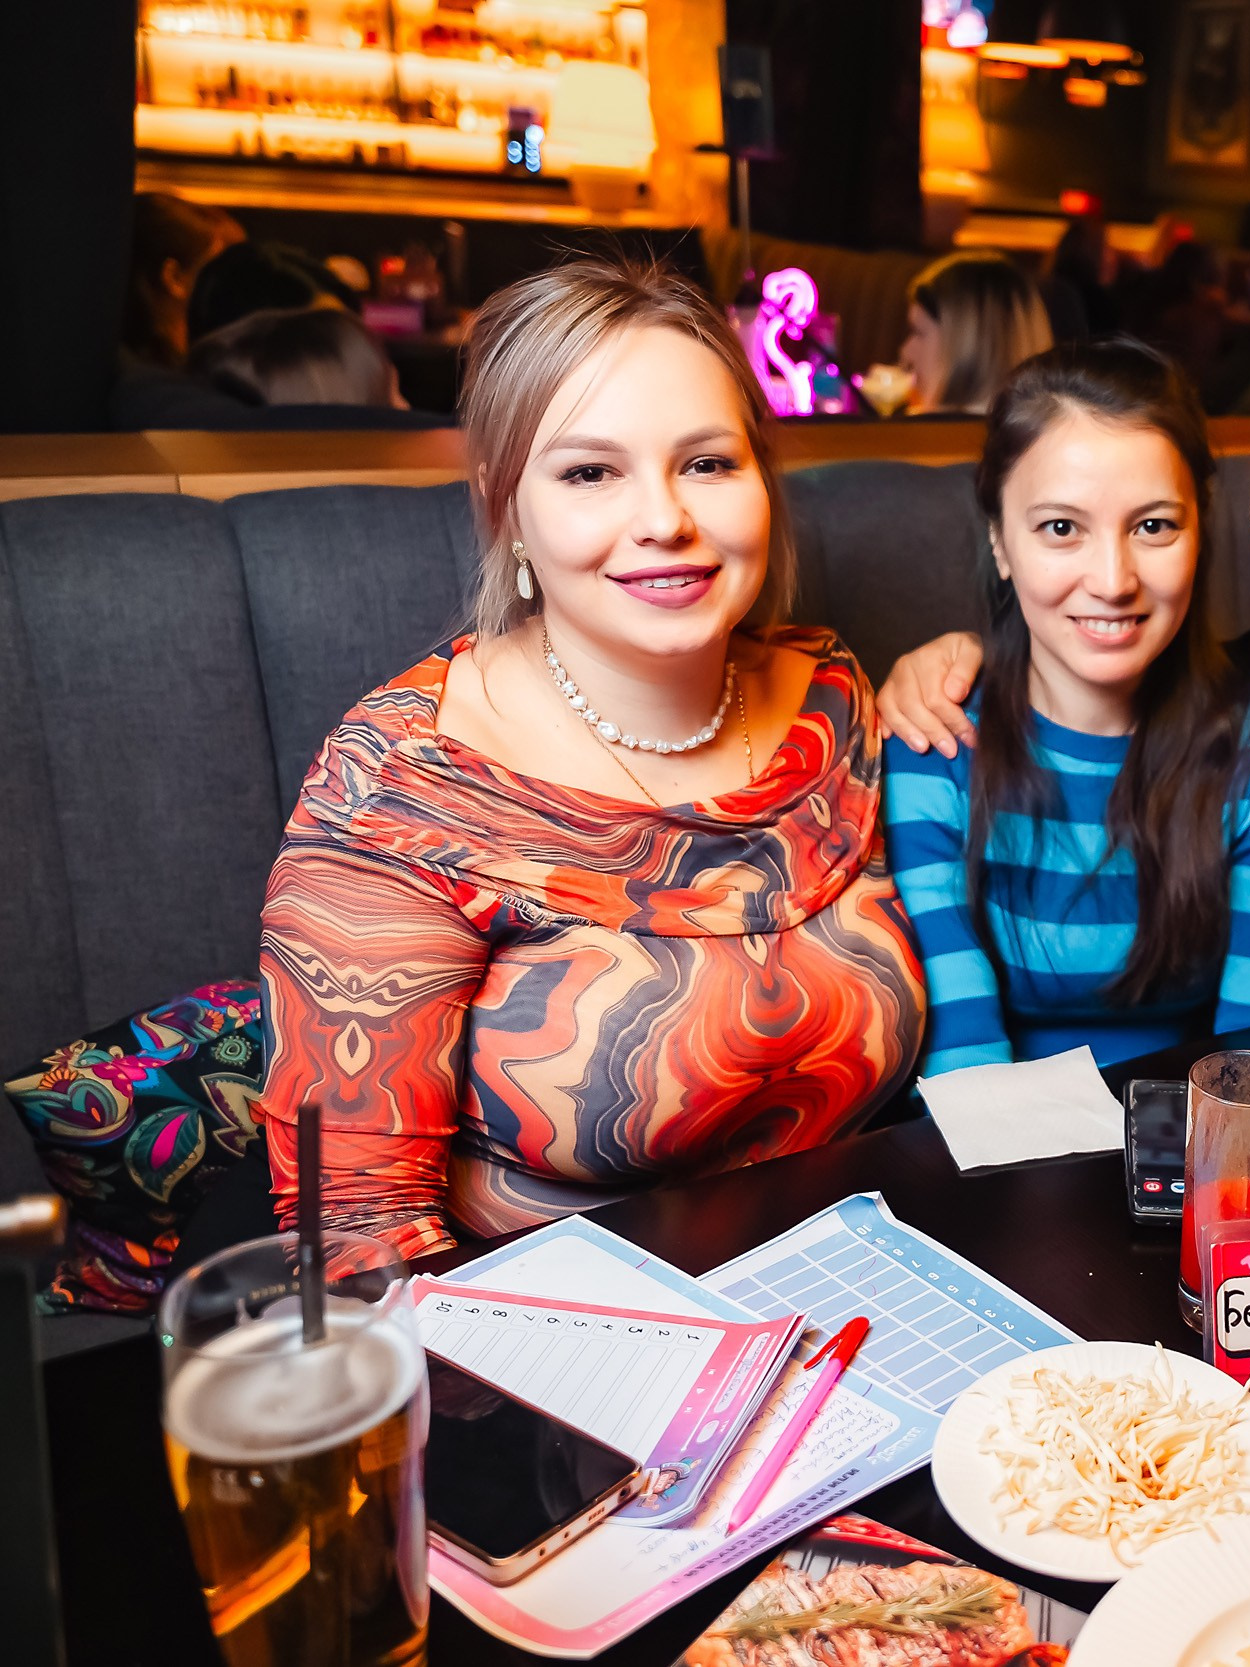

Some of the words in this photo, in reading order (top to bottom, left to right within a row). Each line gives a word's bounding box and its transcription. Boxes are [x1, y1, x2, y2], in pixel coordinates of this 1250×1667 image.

[856, 1224, 873, 1235] 10
[875, 1237, 887, 1245] 9
[893, 1248, 904, 1257] 8
[911, 1259, 922, 1269] 7
[927, 1272, 940, 1281] 6
[947, 1284, 959, 1294] 5
[435, 1301, 453, 1313] 10
[966, 1298, 978, 1307] 4
[492, 1309, 507, 1318] 8
[523, 1313, 535, 1322] 7
[984, 1309, 997, 1319] 3
[547, 1317, 561, 1325] 6
[574, 1320, 588, 1328] 5
[1002, 1320, 1015, 1330] 2
[601, 1322, 614, 1331] 4
[628, 1325, 643, 1334] 3
[1025, 1336, 1037, 1345] 1
[829, 1467, 860, 1488] ИЛИ
[809, 1487, 828, 1502] НА
